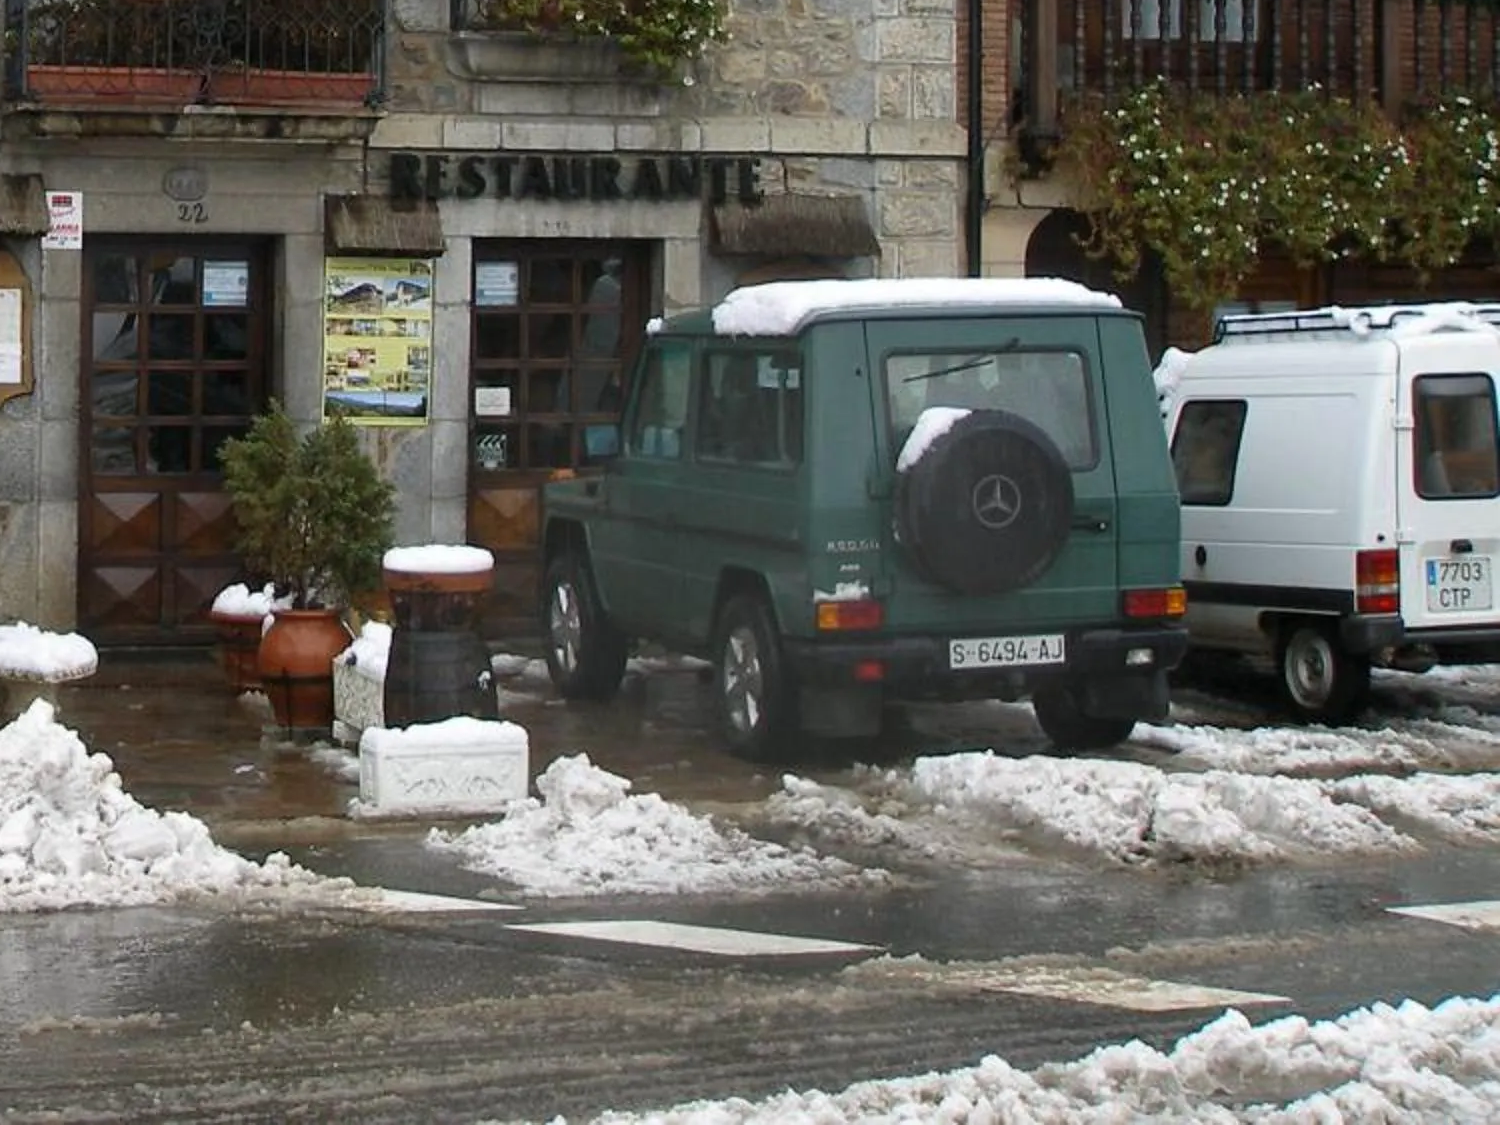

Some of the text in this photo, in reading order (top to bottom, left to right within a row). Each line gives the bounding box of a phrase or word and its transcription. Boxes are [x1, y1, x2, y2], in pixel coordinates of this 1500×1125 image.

[388, 152, 763, 210] RESTAURANTE
[178, 202, 209, 224] 22
[1439, 562, 1482, 583] 7703
[1439, 587, 1471, 608] CTP
